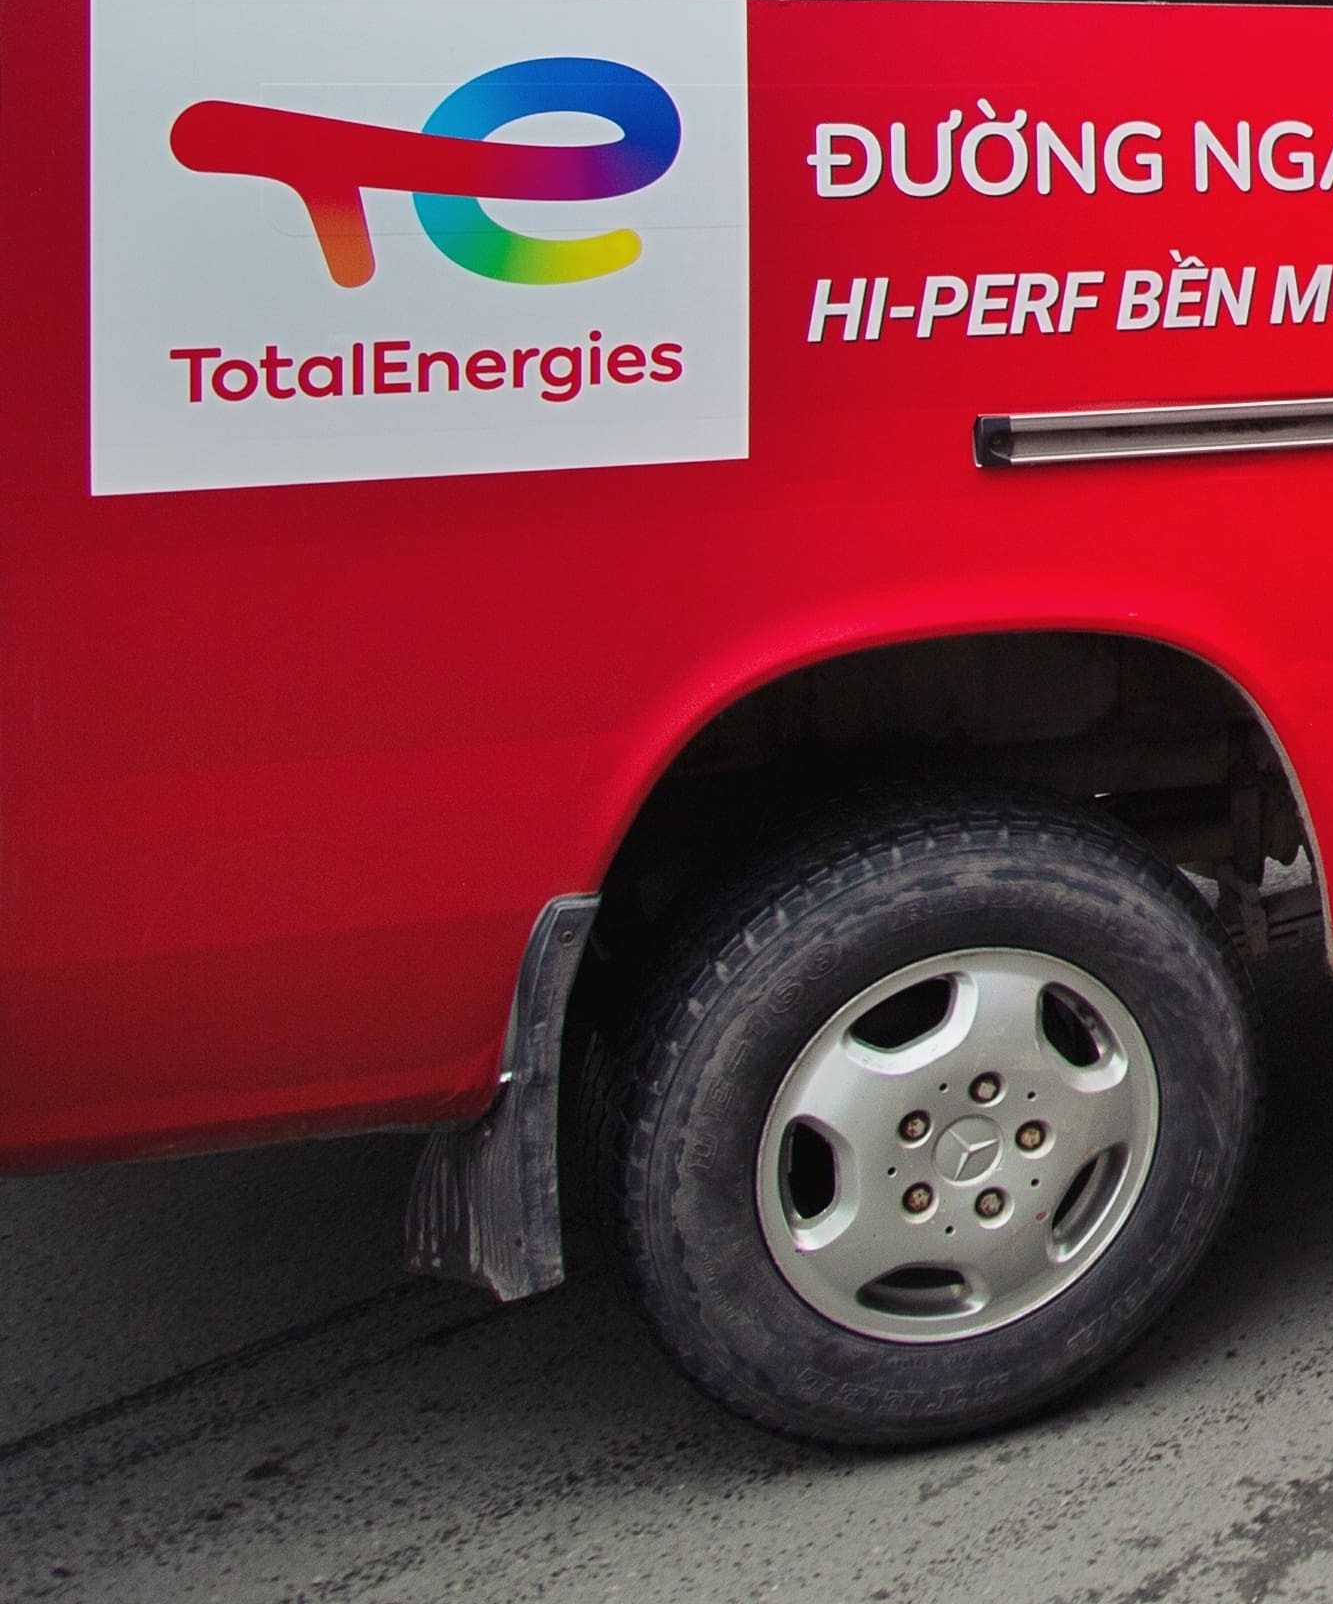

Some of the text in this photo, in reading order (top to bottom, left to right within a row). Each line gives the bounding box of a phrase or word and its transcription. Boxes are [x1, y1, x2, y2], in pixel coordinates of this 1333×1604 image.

[806, 98, 1164, 199] ĐƯỜNG
[806, 270, 1105, 343] HI-PERF
[1116, 249, 1256, 332] BỀN
[169, 331, 684, 403] TotalEnergies
